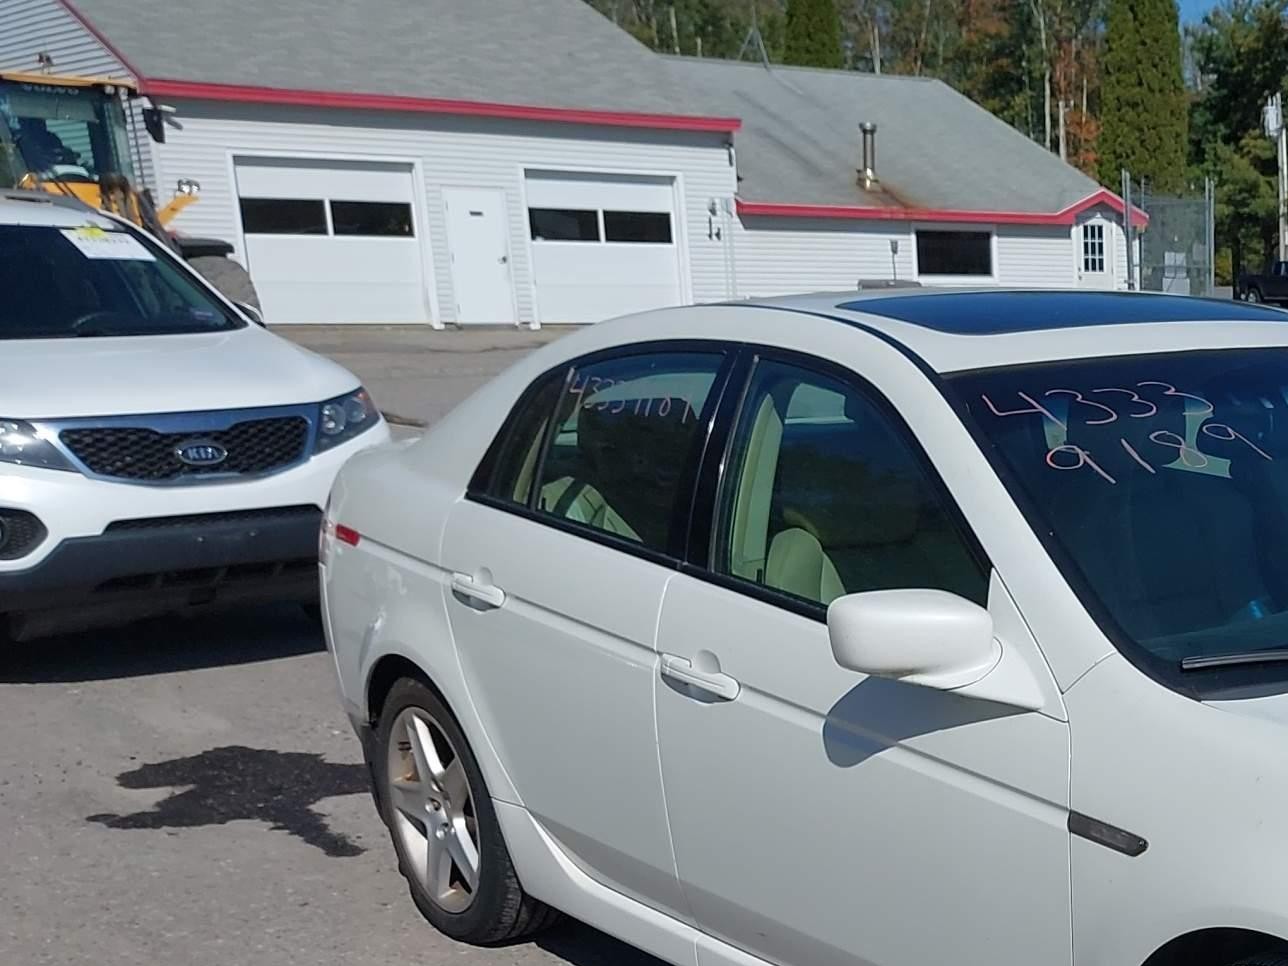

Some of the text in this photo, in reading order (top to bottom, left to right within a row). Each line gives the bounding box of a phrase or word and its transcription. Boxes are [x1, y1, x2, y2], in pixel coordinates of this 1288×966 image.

[981, 381, 1215, 432] 4333
[187, 446, 221, 460] KIA
[1045, 422, 1273, 485] 9189
